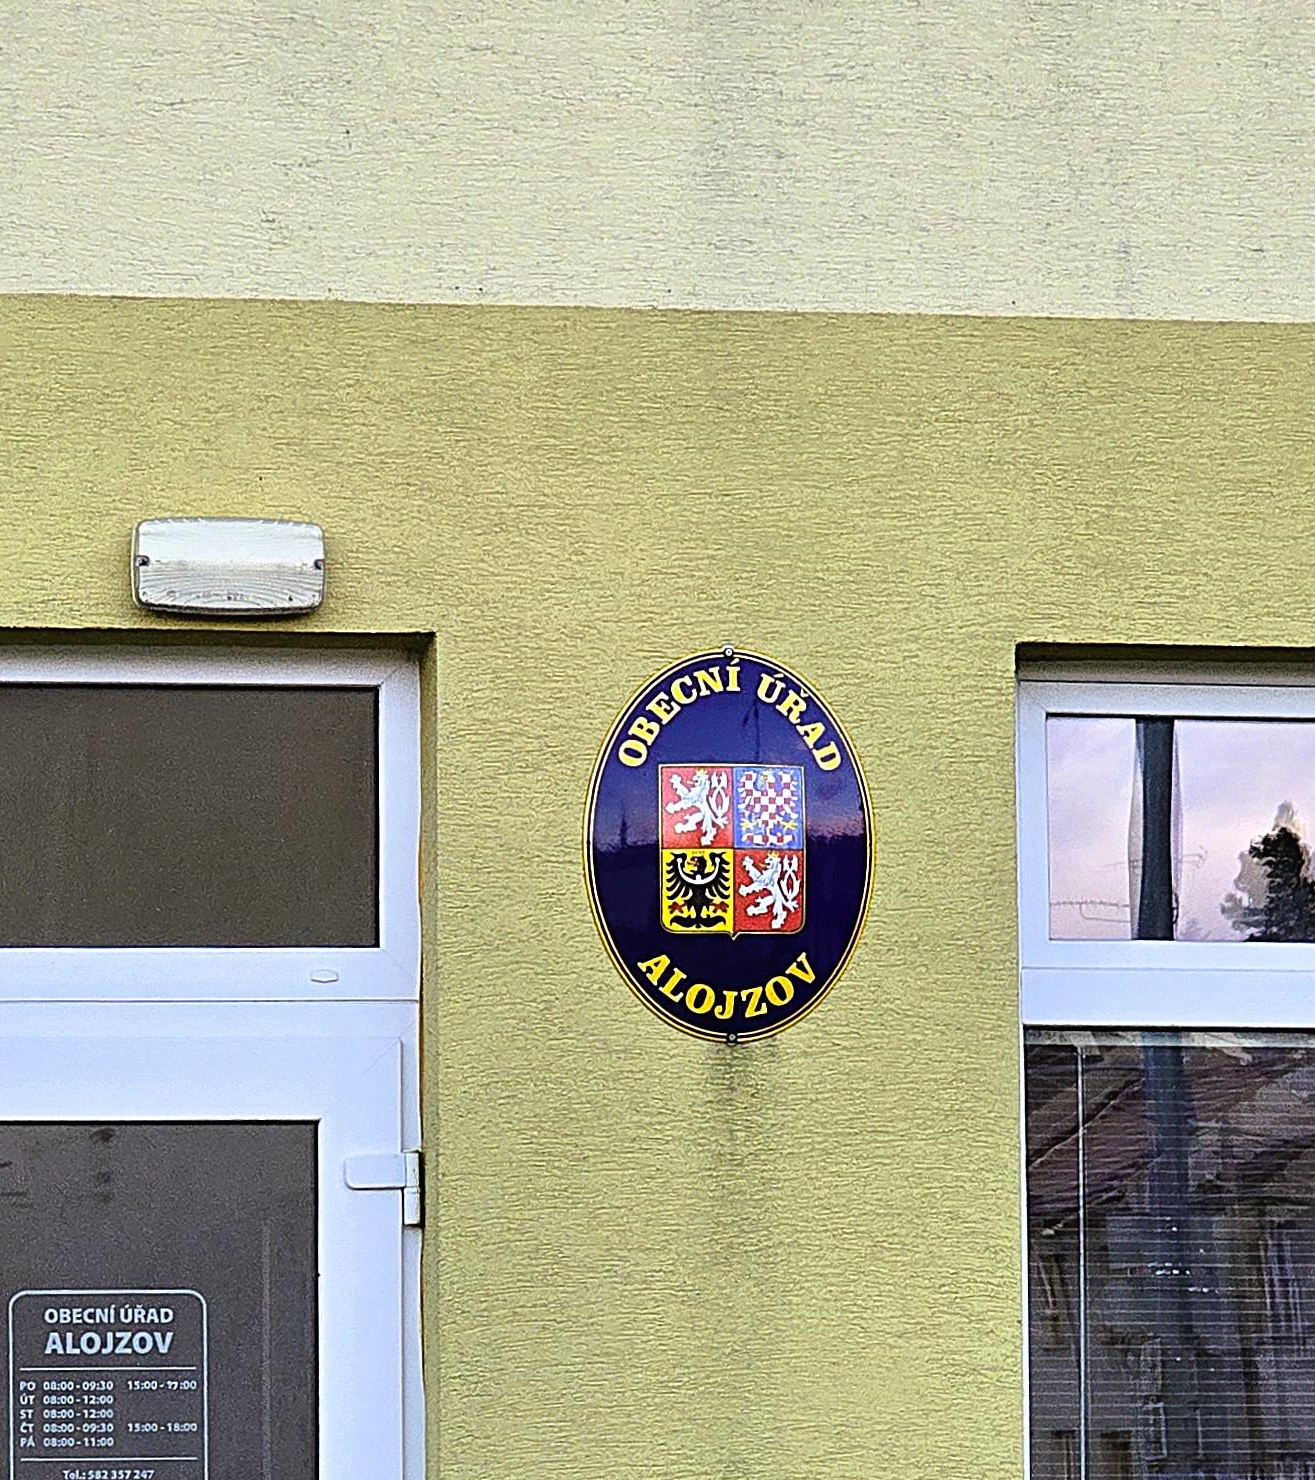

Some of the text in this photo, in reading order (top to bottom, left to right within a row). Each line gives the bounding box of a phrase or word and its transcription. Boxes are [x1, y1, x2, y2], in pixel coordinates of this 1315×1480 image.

[618, 658, 843, 771] OBECNÍ ÚŘAD
[637, 951, 816, 1020] ALOJZOV
[44, 1304, 174, 1324] OBECNÍ ÚŘAD
[44, 1331, 174, 1354] ALOJZOV
[19, 1381, 36, 1391] PO
[43, 1381, 74, 1391] 08:00
[82, 1381, 114, 1391] 09:30
[127, 1381, 158, 1391] 15:00
[19, 1394, 35, 1405] ÚT
[43, 1395, 74, 1405] 08:00
[82, 1395, 114, 1405] 12:00
[19, 1409, 34, 1419] ST
[43, 1409, 74, 1419] 08:00
[82, 1409, 114, 1419] 12:00
[19, 1422, 34, 1433] ČT
[43, 1423, 74, 1433] 08:00
[82, 1423, 114, 1433] 09:30
[127, 1422, 158, 1433] 15:00
[167, 1422, 197, 1433] 18:00
[20, 1436, 35, 1447] PÁ
[43, 1437, 74, 1447] 08:00
[82, 1437, 114, 1447] 11:00
[62, 1470, 155, 1480] Tel.: 582 357 247
